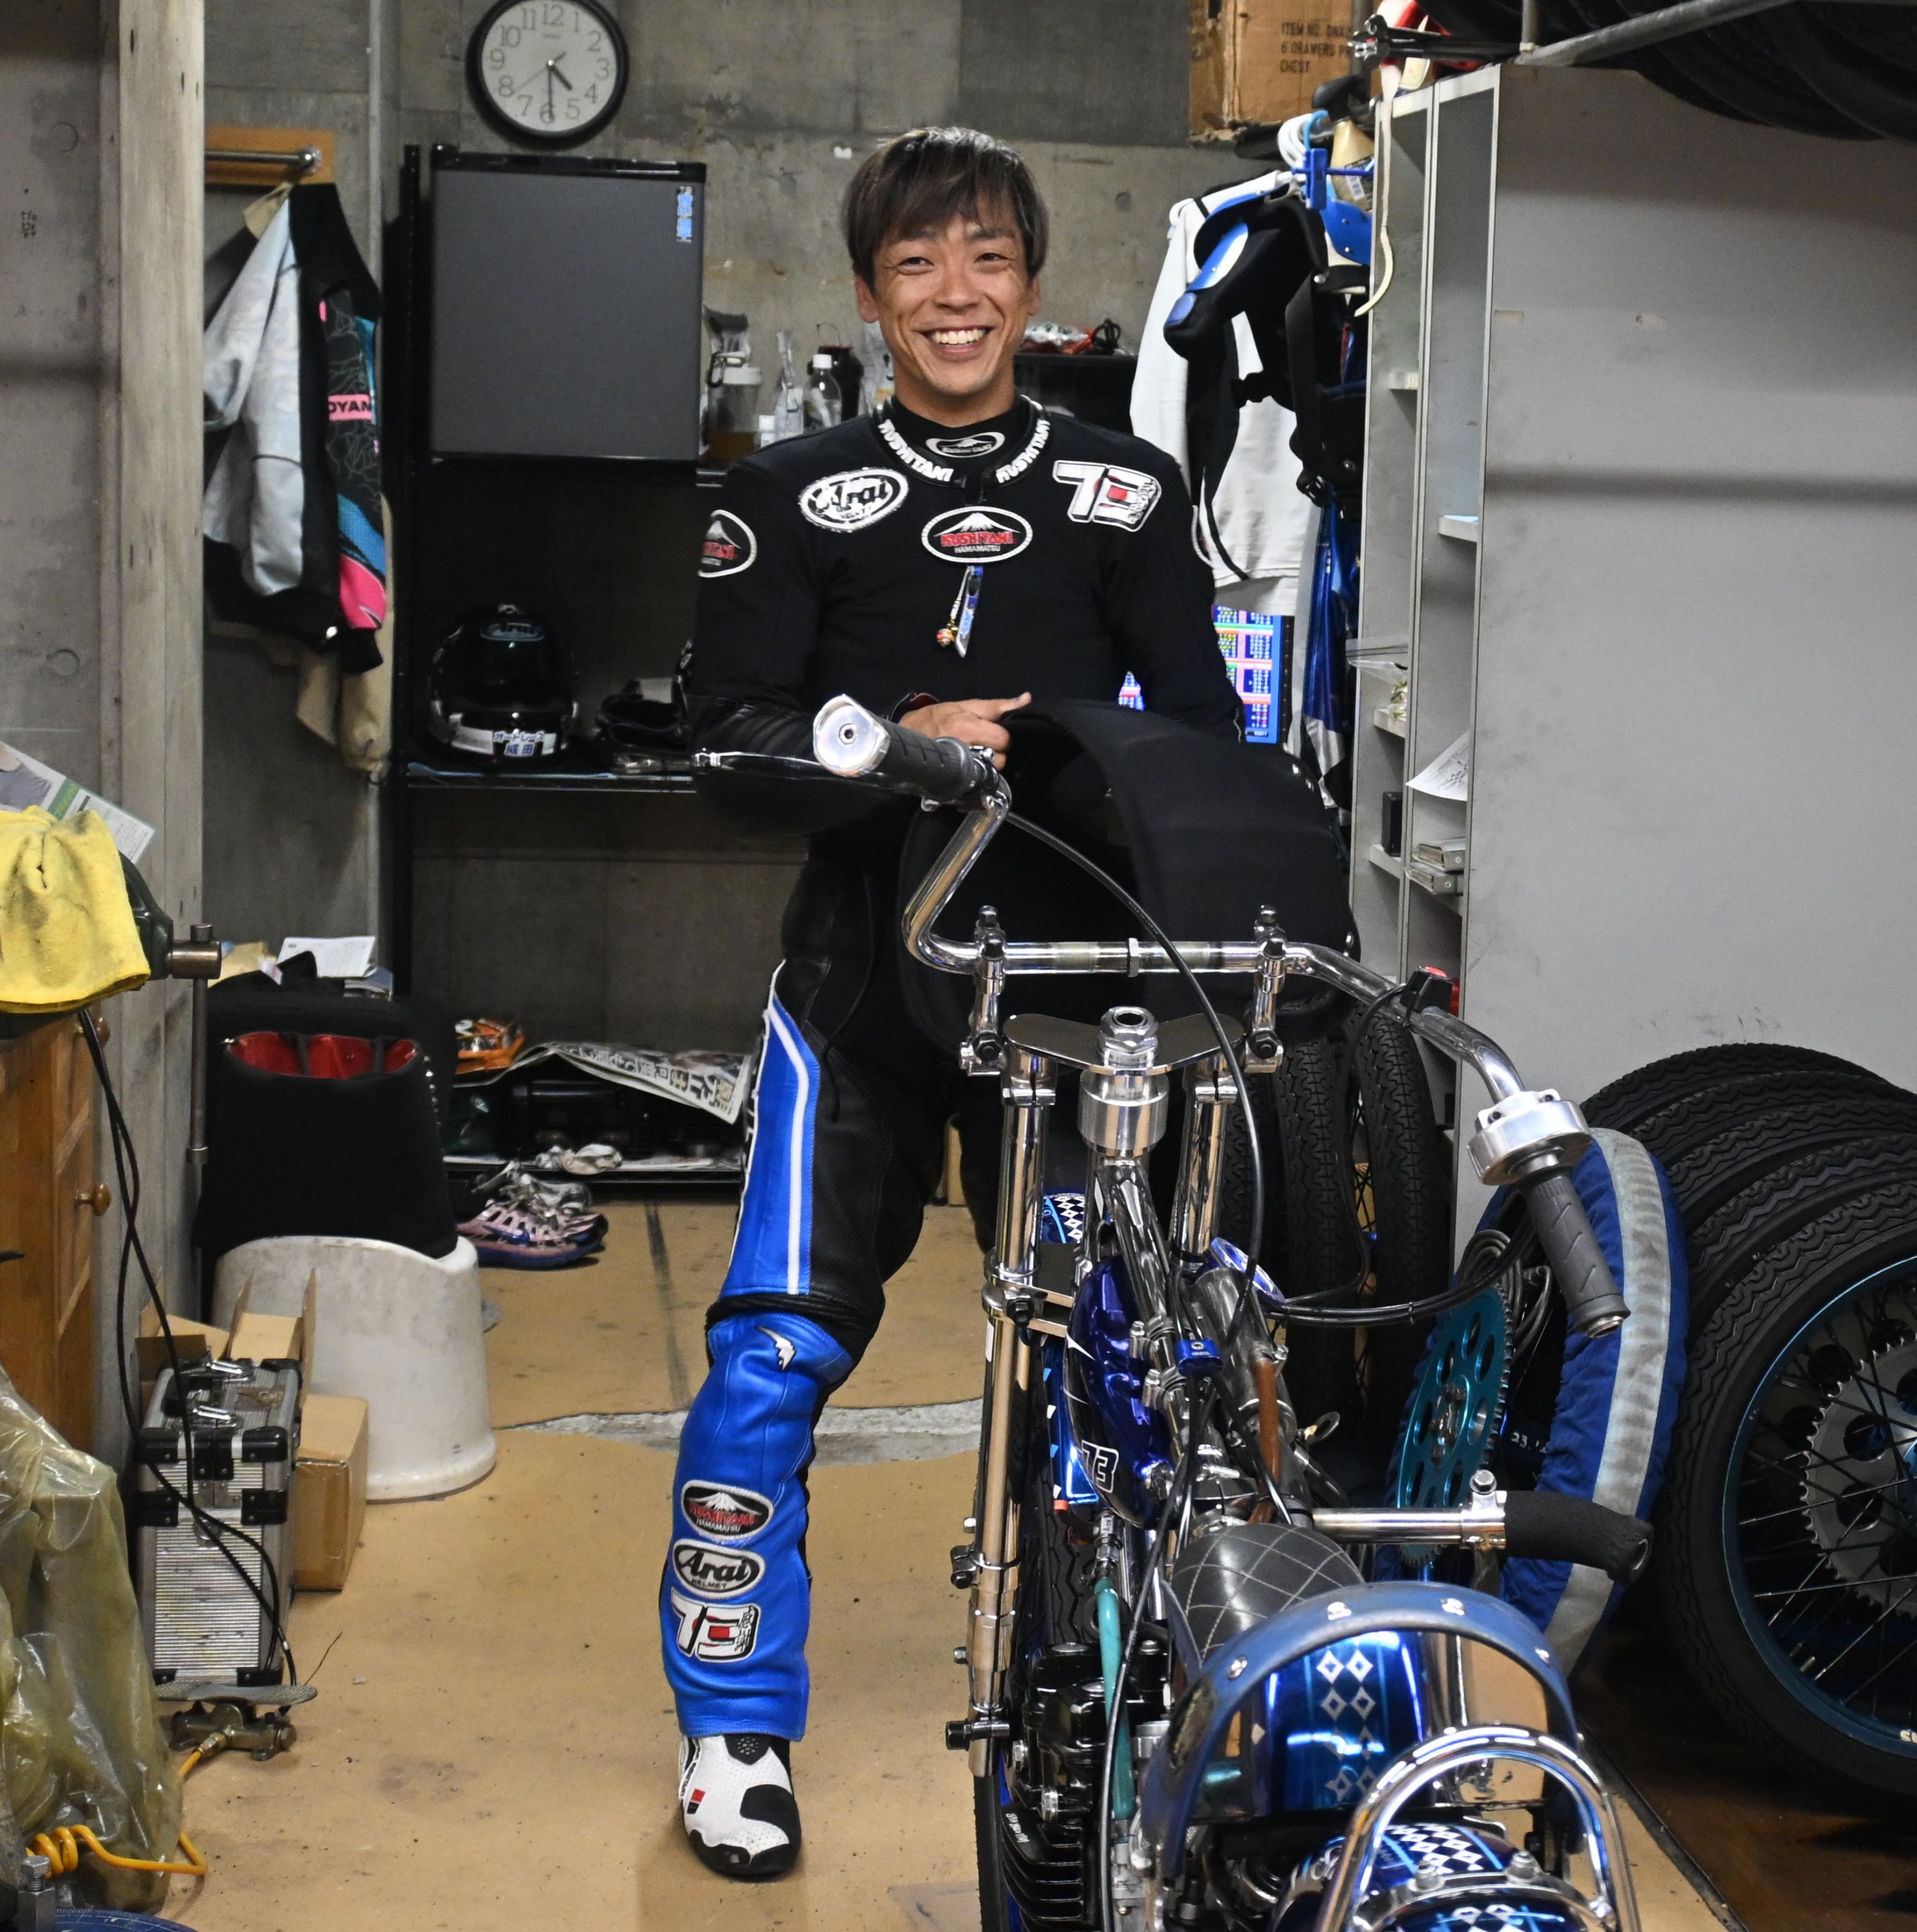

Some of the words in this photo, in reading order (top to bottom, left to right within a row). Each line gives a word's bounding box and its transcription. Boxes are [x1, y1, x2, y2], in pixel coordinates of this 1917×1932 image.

[522, 6, 536, 30] 11
[543, 3, 563, 26] 12
[500, 24, 520, 48] 10
[1281, 22, 1303, 35] ITEM
[587, 30, 601, 52] 2
[490, 48, 505, 70] 9
[596, 57, 609, 80] 3
[498, 75, 515, 97] 8
[585, 83, 598, 104] 4
[517, 95, 533, 117] 7
[540, 103, 554, 124] 6
[566, 98, 580, 120] 5
[954, 545, 1001, 553] HAMAMATSU
[495, 732, 544, 742] オートレース
[1081, 1439, 1119, 1493] 73
[696, 1518, 741, 1533] HAMAMATSU
[679, 1549, 751, 1582] Arai
[692, 1578, 728, 1589] HELMET
